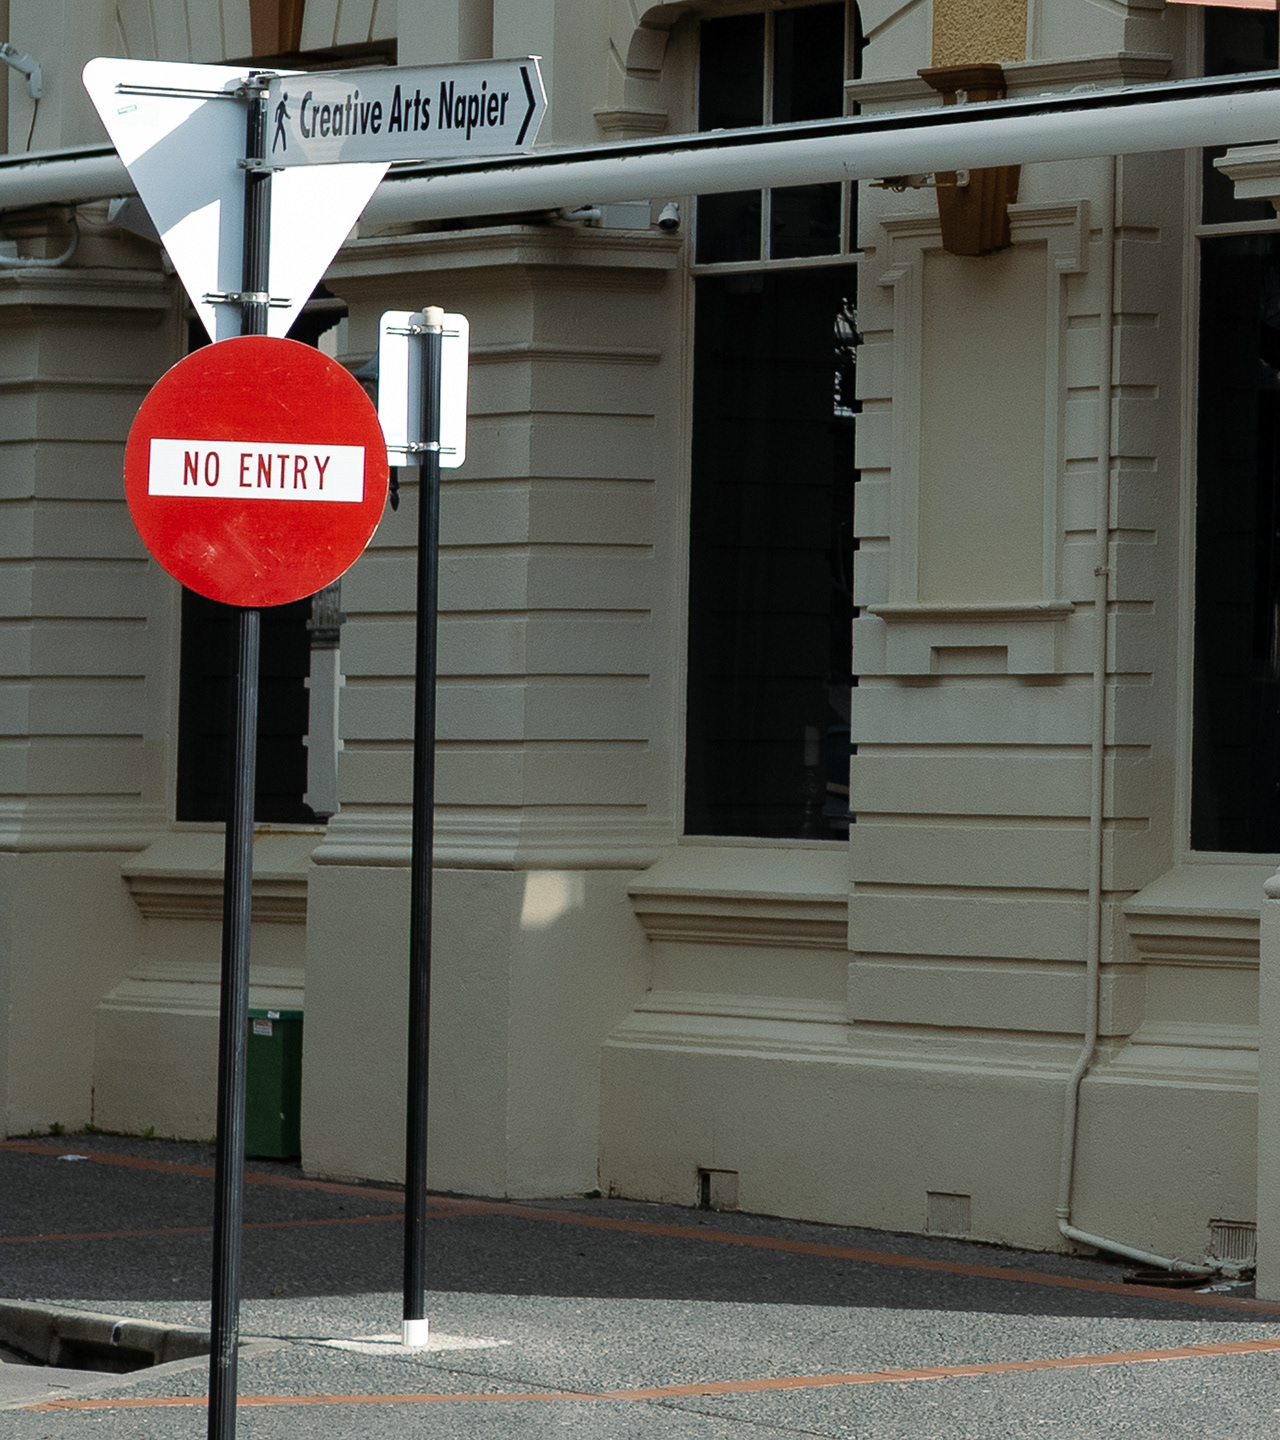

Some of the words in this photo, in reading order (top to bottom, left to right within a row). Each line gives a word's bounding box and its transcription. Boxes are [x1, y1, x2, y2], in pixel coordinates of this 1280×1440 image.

[300, 89, 383, 139] Creative
[388, 84, 431, 133] Arts
[437, 80, 509, 141] Napier
[183, 451, 220, 487] NO
[239, 453, 331, 490] ENTRY
